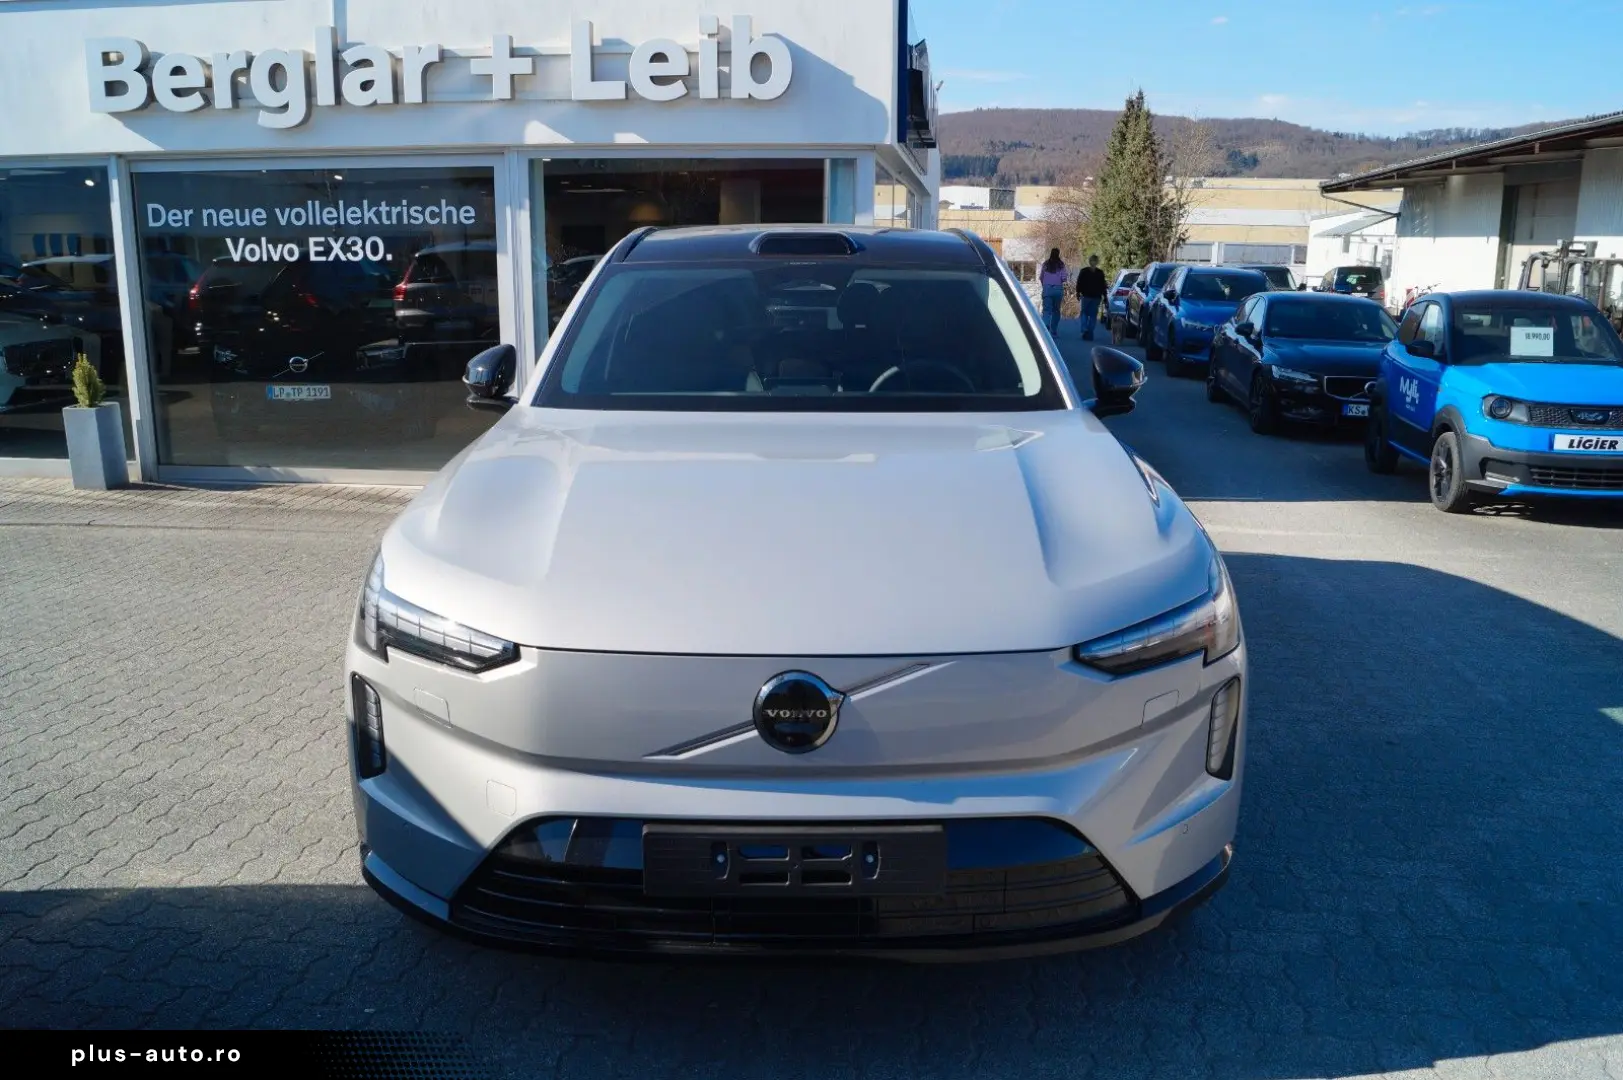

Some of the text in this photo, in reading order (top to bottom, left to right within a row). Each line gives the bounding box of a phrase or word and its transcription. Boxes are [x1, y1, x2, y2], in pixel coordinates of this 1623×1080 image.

[85, 14, 793, 129] Berglar + Leib
[147, 199, 476, 227] Der neue vollelektrische
[226, 236, 393, 263] Volvo EX30.
[1348, 404, 1361, 415] KS
